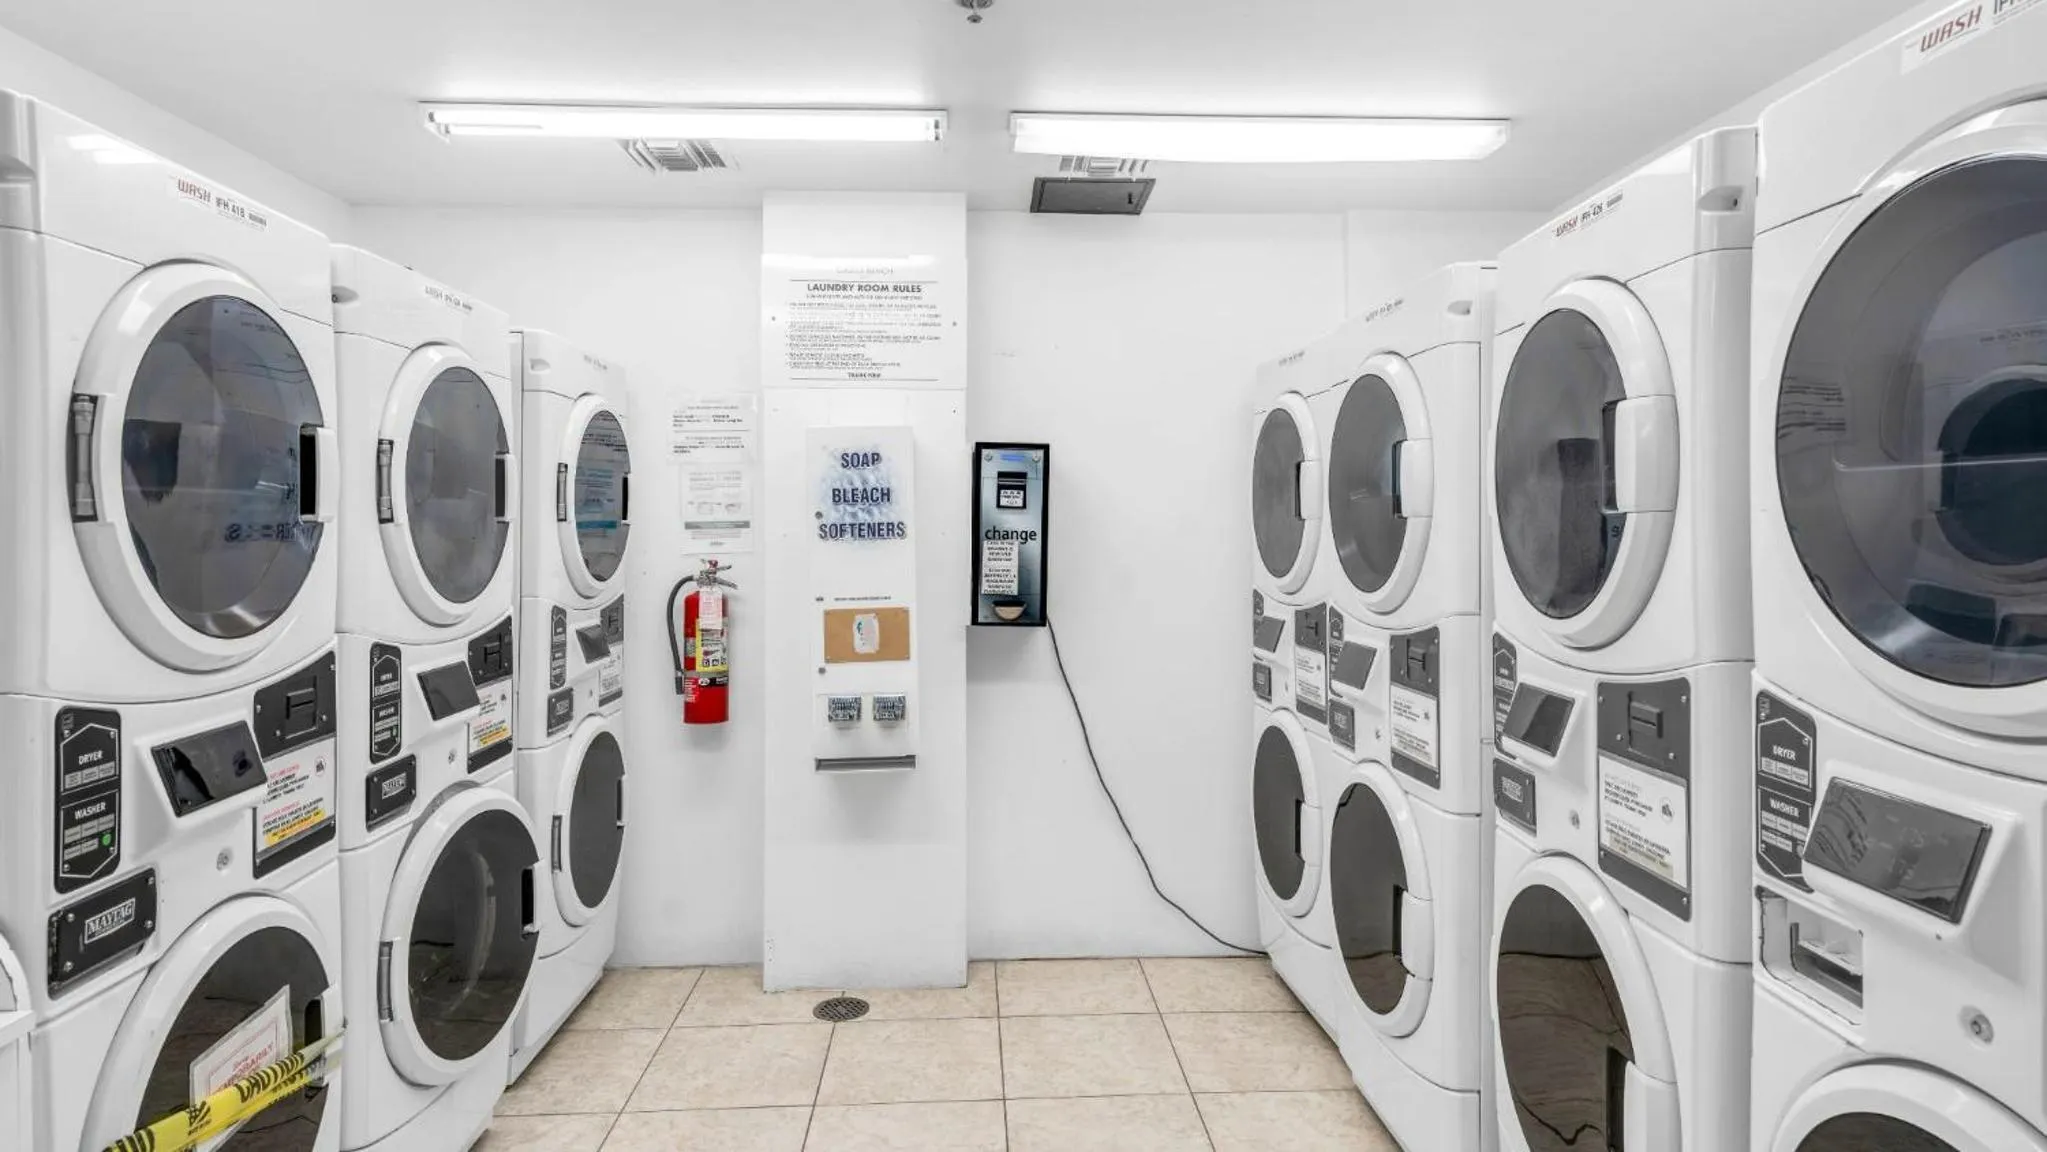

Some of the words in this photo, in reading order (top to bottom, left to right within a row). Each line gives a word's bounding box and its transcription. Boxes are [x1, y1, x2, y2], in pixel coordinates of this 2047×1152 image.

[1920, 4, 1983, 52] WASH
[178, 178, 211, 203] WASH
[807, 283, 855, 293] LAUNDRY
[857, 284, 890, 293] ROOM
[892, 284, 922, 293] RULES
[841, 452, 882, 469] SOAP
[831, 487, 891, 504] BLEACH
[818, 520, 906, 540] SOFTENERS
[984, 525, 1037, 545] change
[78, 749, 104, 765] DRYER
[1772, 744, 1797, 761] DRYER
[74, 802, 106, 820] WASHER
[1770, 797, 1800, 818] WASHER
[86, 902, 134, 934] MAYTAG
[235, 1050, 306, 1103] CAUTION
